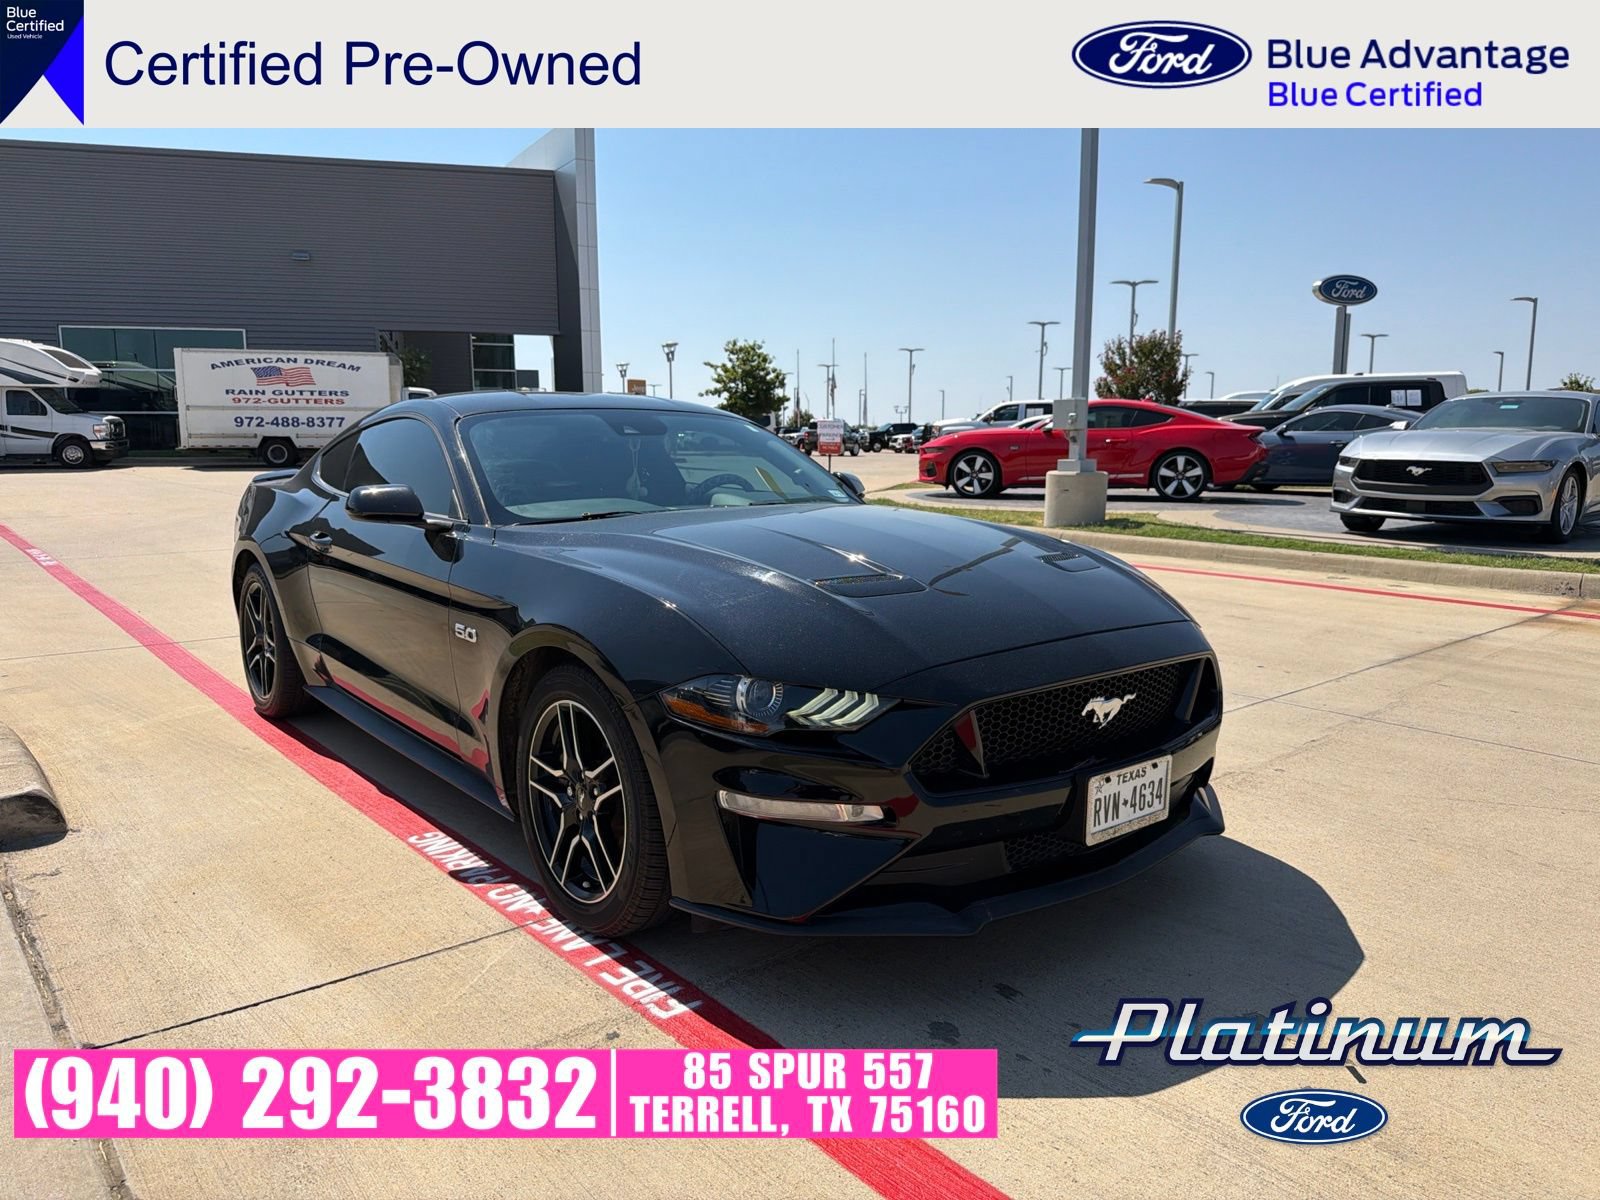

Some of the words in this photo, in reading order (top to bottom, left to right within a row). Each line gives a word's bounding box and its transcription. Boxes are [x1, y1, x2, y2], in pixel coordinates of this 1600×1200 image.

[1331, 279, 1367, 299] Ford
[210, 357, 298, 370] AMERICAN
[303, 358, 361, 373] DREAM
[225, 389, 266, 397] RAIN
[271, 389, 350, 398] GUTTERS
[231, 397, 345, 406] 972-GUTTERS
[233, 416, 346, 428] 972-488-8377
[1116, 766, 1147, 785] TEXAS
[406, 831, 512, 888] PARKING
[487, 883, 547, 912] NO
[524, 918, 628, 967] LANE
[599, 959, 703, 1020] FIRE
